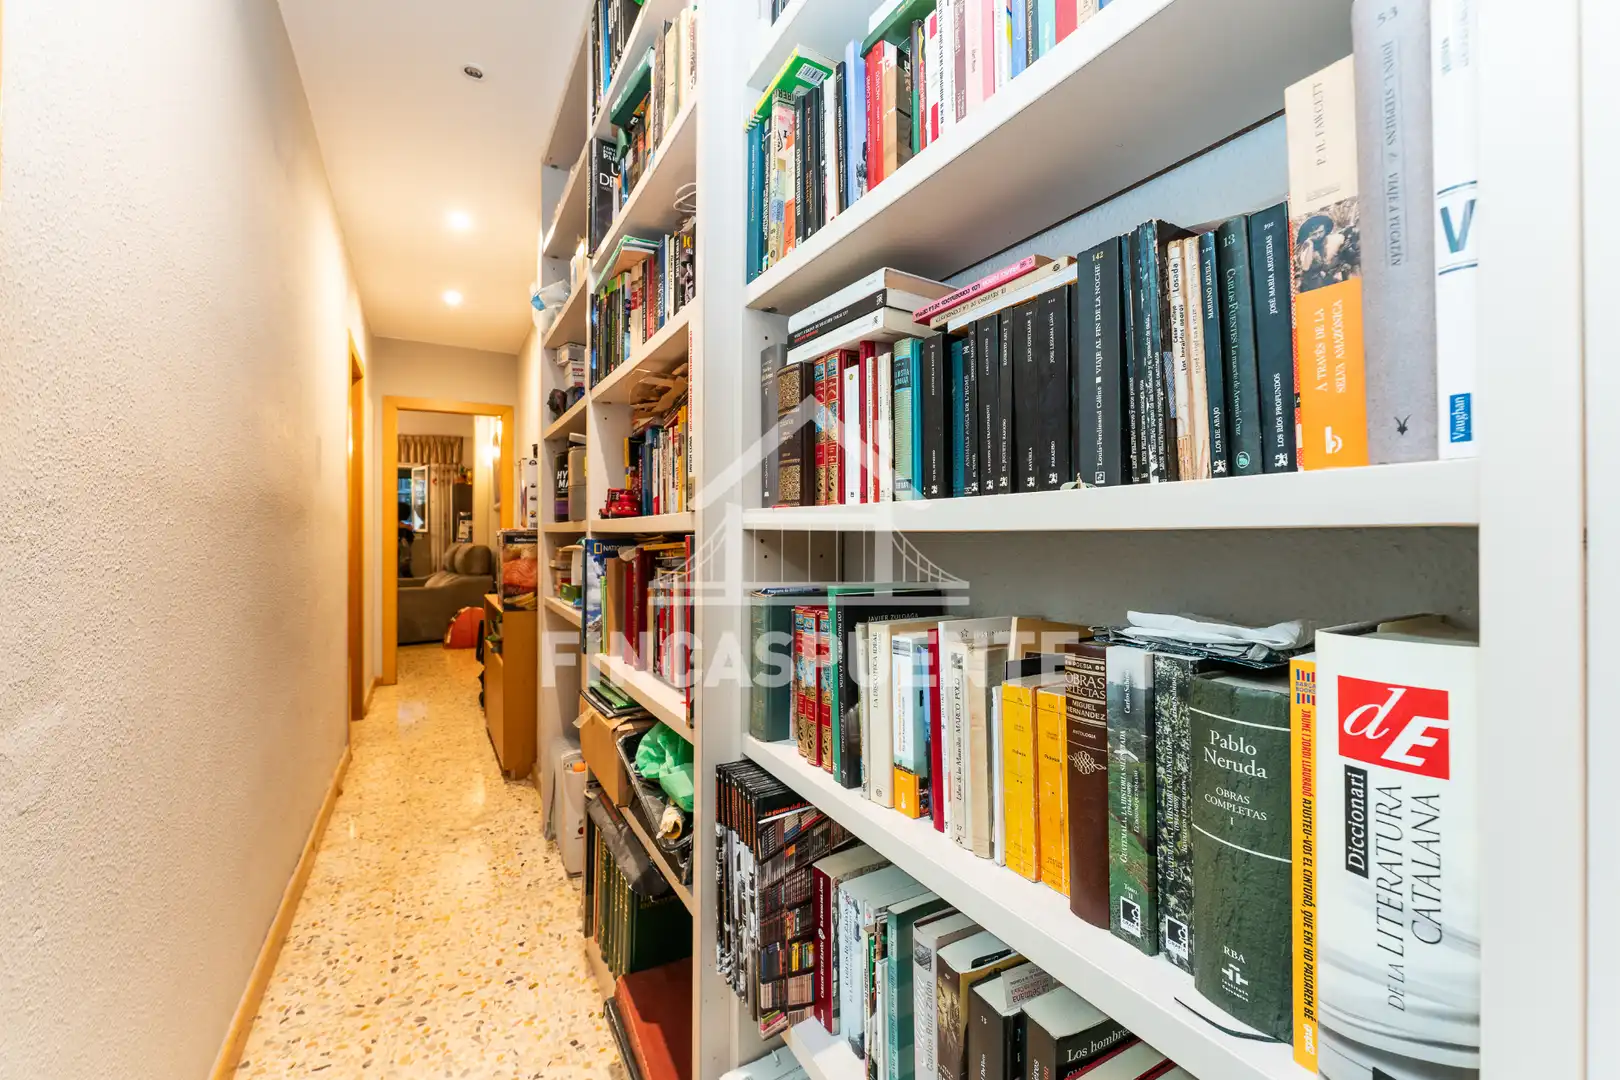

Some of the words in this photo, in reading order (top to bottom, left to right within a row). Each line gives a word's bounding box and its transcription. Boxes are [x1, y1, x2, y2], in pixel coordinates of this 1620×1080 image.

[1312, 82, 1325, 137] FAWCETT
[1387, 172, 1398, 204] VIAJE
[1224, 234, 1235, 247] 13
[1389, 216, 1403, 266] YUCATÁN
[1092, 251, 1104, 261] 142
[1265, 235, 1274, 272] ARGUEDAS
[1170, 263, 1179, 293] Losada
[1204, 260, 1212, 285] AZUELA
[1226, 268, 1237, 303] CARLOS
[1268, 274, 1276, 296] MARÍA
[1094, 296, 1101, 307] LA
[1206, 287, 1214, 319] MARIANO
[1269, 298, 1278, 314] JOSÉ
[1095, 308, 1101, 321] DE
[1227, 304, 1239, 344] FUENTES
[1314, 308, 1325, 322] LA
[1314, 323, 1325, 339] DE
[1331, 299, 1345, 360] AMAZÓNICA
[1095, 339, 1102, 349] AL
[1231, 345, 1239, 354] La
[1095, 350, 1103, 374] VIAJE
[1231, 355, 1240, 379] muerte
[1314, 341, 1327, 381] TRAVÉS
[1233, 380, 1240, 388] de
[1317, 383, 1328, 392] A
[1333, 362, 1346, 393] SELVA
[1233, 389, 1242, 416] Artemio
[1274, 373, 1283, 414] PROFUNDOS
[1234, 418, 1242, 436] Cruz
[1276, 416, 1284, 430] RÍOS
[1451, 396, 1469, 440] Vaughan
[1214, 429, 1220, 439] DE
[1276, 432, 1284, 447] LOS
[1214, 440, 1222, 452] LOS
[868, 614, 888, 623] JAVIER
[1065, 671, 1105, 689] OBRAS
[873, 698, 878, 708] LA
[1065, 684, 1106, 700] SELECTAS
[1123, 692, 1131, 714] Carlos
[1072, 699, 1097, 711] MIGUEL
[1300, 709, 1311, 731] JAUME
[1343, 687, 1451, 767] dE
[1209, 729, 1257, 756] Pablo
[1301, 738, 1312, 759] JORDI
[1203, 747, 1268, 779] Neruda
[1301, 760, 1315, 797] LLAURADÓ
[1166, 786, 1174, 819] HISTORIA
[1216, 786, 1250, 805] OBRAS
[1120, 807, 1127, 815] LA
[1204, 793, 1267, 821] COMPLETAS
[1167, 821, 1174, 831] LA
[1230, 817, 1234, 825] I
[1302, 798, 1313, 855] AJUSTEU-VOS
[1348, 772, 1366, 870] Diccionari
[1119, 817, 1128, 863] GUATEMALA,
[1164, 831, 1175, 881] GUATEMALA,
[1303, 857, 1312, 868] EL
[1375, 785, 1404, 957] LITERATURA
[1410, 793, 1442, 945] CATALANA
[1301, 869, 1315, 908] CINTURÓ,
[1300, 910, 1313, 928] QUE
[1303, 930, 1314, 946] ENS
[1223, 945, 1246, 964] RBA
[1304, 948, 1313, 961] HO
[1303, 962, 1315, 1007] PASSAREM
[1387, 963, 1405, 984] LA
[925, 981, 933, 1010] Zafón
[1388, 986, 1405, 1012] DE
[1304, 1008, 1317, 1021] BÉ
[925, 1039, 934, 1071] Carlos
[1066, 1046, 1088, 1062] Los
